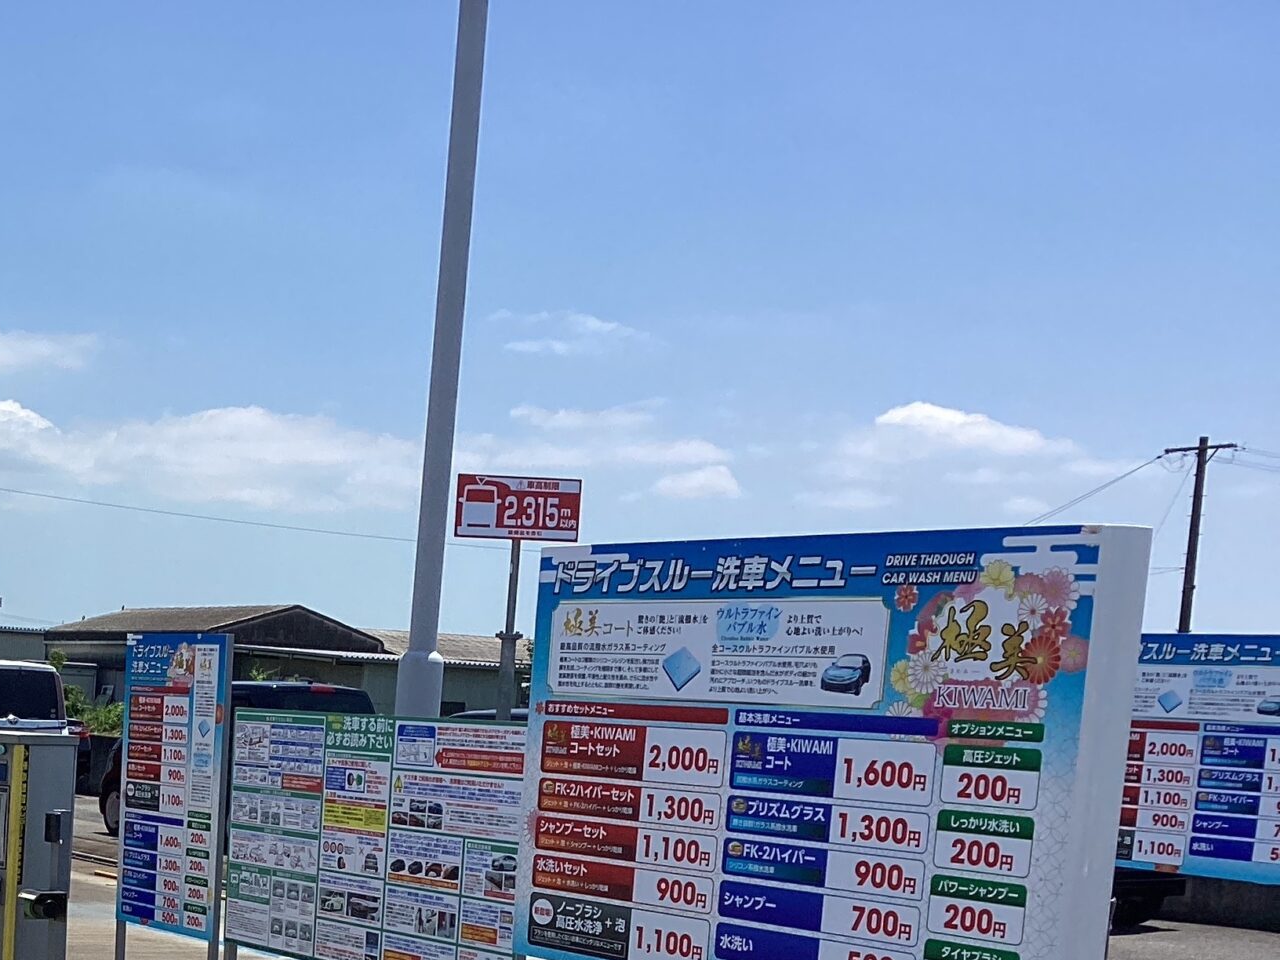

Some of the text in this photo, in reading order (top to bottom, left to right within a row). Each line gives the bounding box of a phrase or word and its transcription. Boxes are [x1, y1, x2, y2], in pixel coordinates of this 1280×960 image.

[503, 496, 560, 528] 2.315
[560, 519, 577, 529] 以内
[886, 553, 975, 567] DRIVE THROUGH
[553, 555, 877, 594] ドライブスルー洗車メニュー
[882, 570, 976, 584] CAR WASH MENU
[716, 607, 784, 620] ウルトラファイン
[786, 614, 822, 625] より上質で
[726, 621, 768, 634] バブル水
[712, 644, 836, 655] 全コースウルトラファインバブル水使用
[931, 600, 1039, 681] 極美
[132, 644, 174, 658] ドライブスルー
[131, 661, 168, 673] 洗車メニュー
[934, 685, 1029, 710] KIWAMI
[548, 703, 615, 715] おすすめセットメニュー
[738, 711, 801, 725] 基本洗車メニュー
[343, 715, 394, 733] 洗車する前に
[951, 723, 1033, 738] オプションメニュー
[326, 731, 393, 749] 必ずお読み下さい
[569, 742, 620, 758] コートセット
[962, 749, 1021, 766] 高圧ジェット
[1147, 741, 1194, 758] 2,000円
[1222, 748, 1240, 756] コート
[649, 745, 719, 774] 2,000円
[765, 756, 792, 771] コート
[843, 758, 927, 791] 1,600円
[1145, 767, 1191, 785] 1,300円
[1212, 771, 1260, 782] プリズムグラス
[555, 782, 635, 803] FK-2ハイパーセット
[957, 773, 1021, 804] 200円
[1143, 790, 1188, 807] 1,100円
[1208, 793, 1254, 804] FK-2ハイパー
[647, 793, 714, 825] 1,300円
[748, 800, 826, 822] プリズムグラス
[539, 819, 607, 840] シャンプーセット
[839, 812, 922, 848] 1,300円
[950, 815, 1020, 833] しっかり水洗い
[1152, 813, 1185, 830] 900円
[1195, 818, 1230, 829] シャンプー
[643, 834, 711, 867] 1,100円
[743, 843, 816, 864] FK-2ハイパー
[951, 838, 1014, 871] 200円
[1137, 839, 1181, 858] 1,100円
[1191, 841, 1214, 853] 水洗い
[536, 858, 588, 877] 水洗いセット
[855, 860, 917, 895] 900円
[656, 877, 707, 909] 900円
[938, 880, 1019, 899] パワーシャンプー
[557, 901, 602, 919] ノーブラシ
[723, 892, 777, 910] シャンプー
[555, 914, 603, 935] 高圧水洗浄
[851, 905, 912, 941] 700円
[943, 904, 1007, 939] 200円
[719, 933, 753, 951] 水洗い
